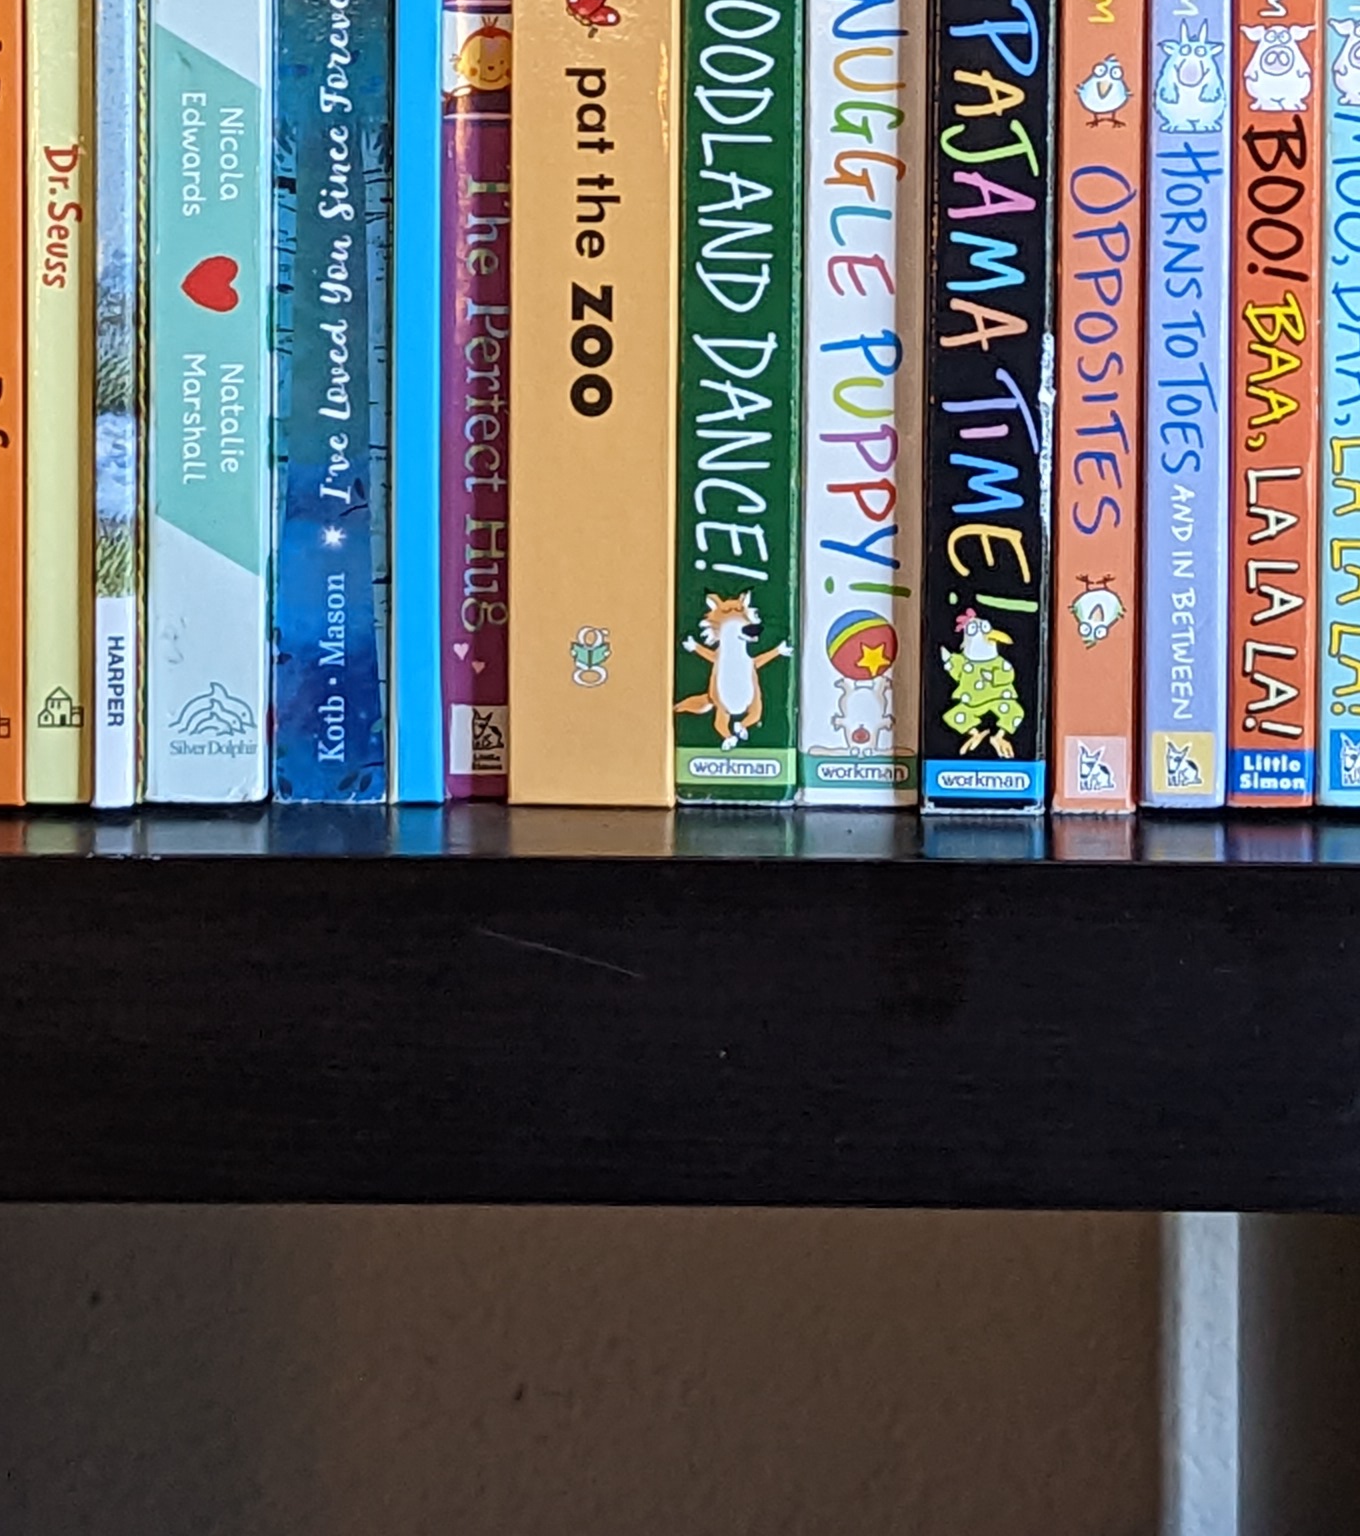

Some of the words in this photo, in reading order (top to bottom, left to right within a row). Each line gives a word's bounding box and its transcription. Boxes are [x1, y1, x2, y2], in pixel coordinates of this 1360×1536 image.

[181, 91, 206, 216] Edwards
[219, 105, 244, 202] Nicola
[565, 67, 615, 155] pat
[318, 125, 355, 221] Since
[575, 175, 622, 259] the
[1157, 142, 1223, 300] HORNS
[1242, 114, 1309, 283] BOO!
[318, 233, 353, 304] You
[318, 319, 352, 420] Loved
[1070, 165, 1137, 534] OPPOSITES
[1244, 292, 1306, 453] BAA,
[182, 353, 207, 484] Marshall
[219, 363, 244, 474] Natalie
[693, 332, 777, 581] DANCE!
[819, 329, 911, 598] PUPPY!
[940, 368, 1039, 612] TIME!
[1171, 484, 1195, 542] AND
[1245, 467, 1303, 542] LA
[460, 515, 509, 633] Hug
[1171, 552, 1195, 579] IN
[1245, 560, 1304, 625] LA
[320, 572, 346, 667] Mason
[1171, 587, 1196, 720] BETWEEN
[107, 635, 126, 727] HARPER
[318, 690, 346, 762] Kotb
[1243, 640, 1304, 738] LA!
[693, 761, 776, 776] workman
[821, 765, 904, 781] workman
[941, 772, 1026, 789] workman
[1240, 775, 1305, 790] Simon
[1243, 755, 1301, 771] Little
